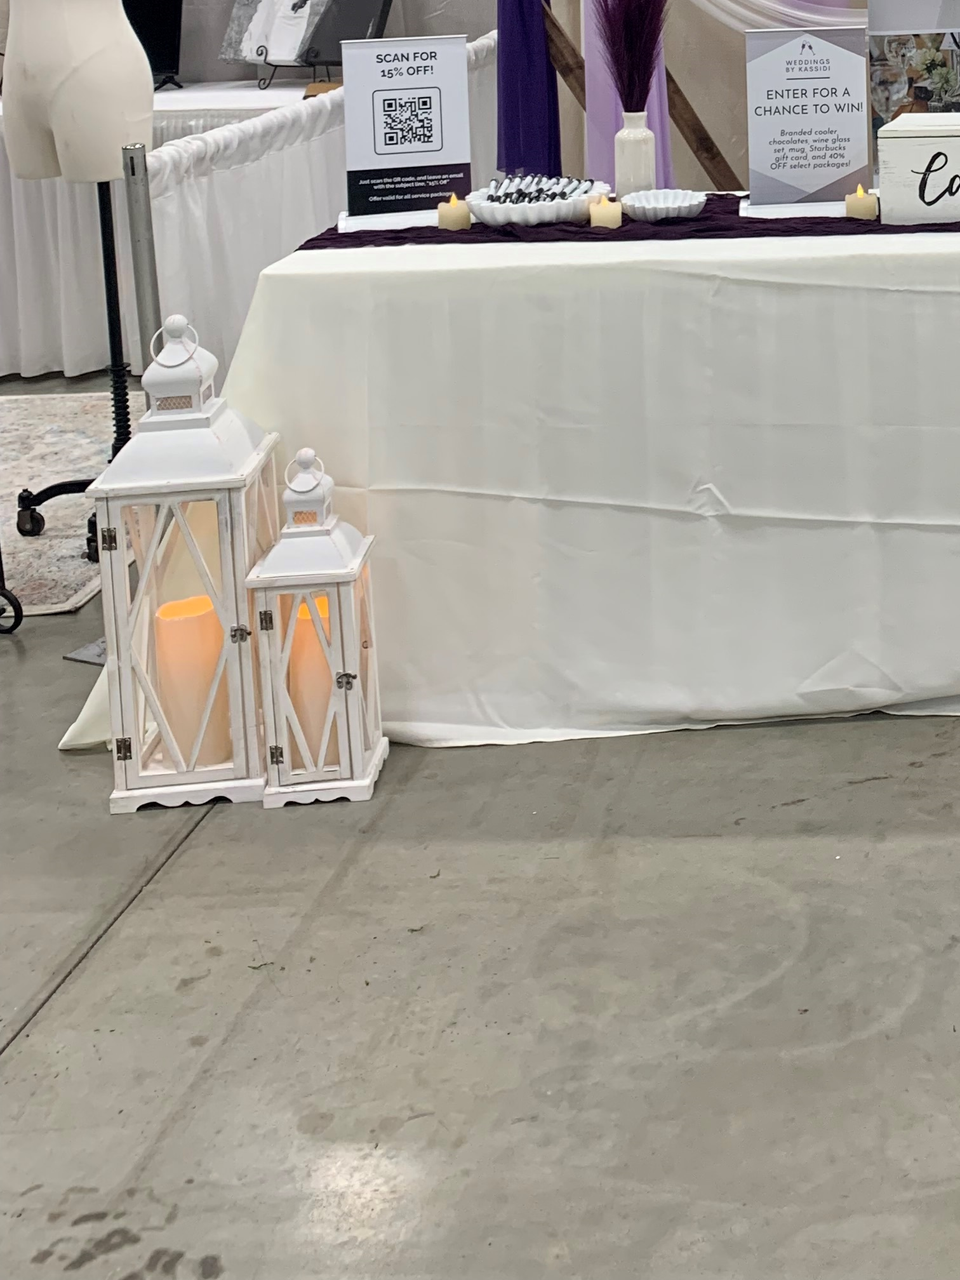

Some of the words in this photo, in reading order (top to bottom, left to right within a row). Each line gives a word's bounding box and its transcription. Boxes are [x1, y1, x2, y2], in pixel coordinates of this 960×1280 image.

[376, 53, 410, 64] SCAN
[413, 51, 438, 62] FOR
[381, 67, 404, 79] 15%
[406, 65, 434, 77] OFF!
[767, 88, 808, 100] ENTER
[813, 88, 838, 99] FOR
[842, 87, 851, 97] A
[754, 104, 809, 117] CHANCE
[812, 104, 830, 115] TO
[834, 102, 864, 114] WIN!
[780, 128, 813, 137] Branded
[769, 137, 810, 146] chocolates,
[831, 135, 851, 145] glass
[809, 144, 846, 152] Starbucks
[774, 153, 789, 163] gift
[813, 160, 851, 170] packages!
